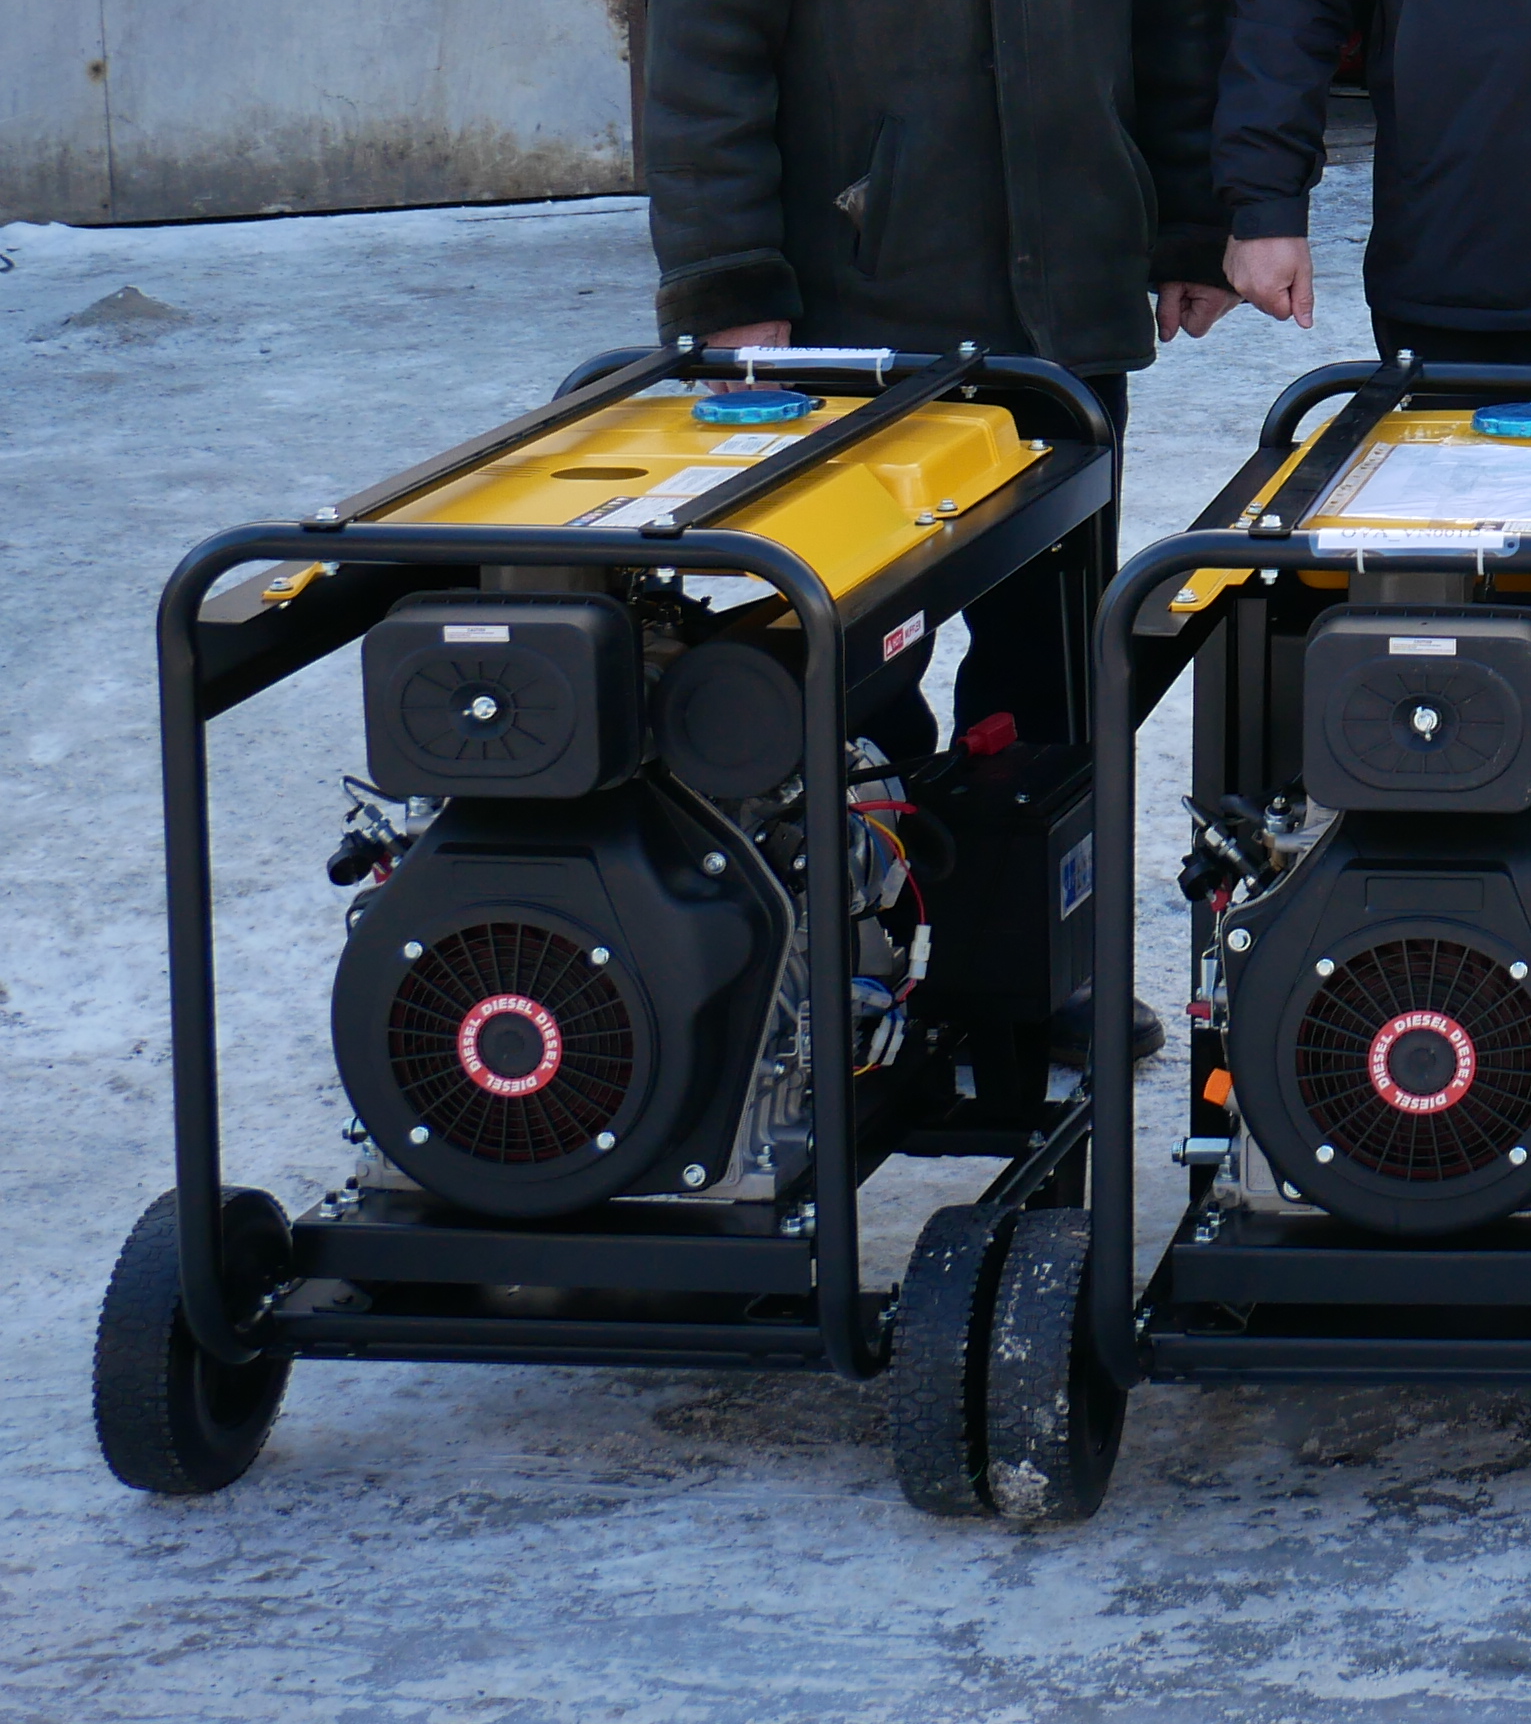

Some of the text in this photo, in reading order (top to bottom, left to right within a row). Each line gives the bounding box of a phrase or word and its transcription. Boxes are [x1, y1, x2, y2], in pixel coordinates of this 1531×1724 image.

[481, 998, 533, 1016] DIESEL
[1394, 1015, 1447, 1033] DIESEL
[463, 1019, 481, 1073] DIESEL
[535, 1011, 557, 1070] DIESEL
[1450, 1029, 1471, 1088] DIESEL
[1373, 1035, 1393, 1089] DIESEL
[487, 1074, 537, 1092] DIESEL
[1394, 1090, 1447, 1109] DIESEL
